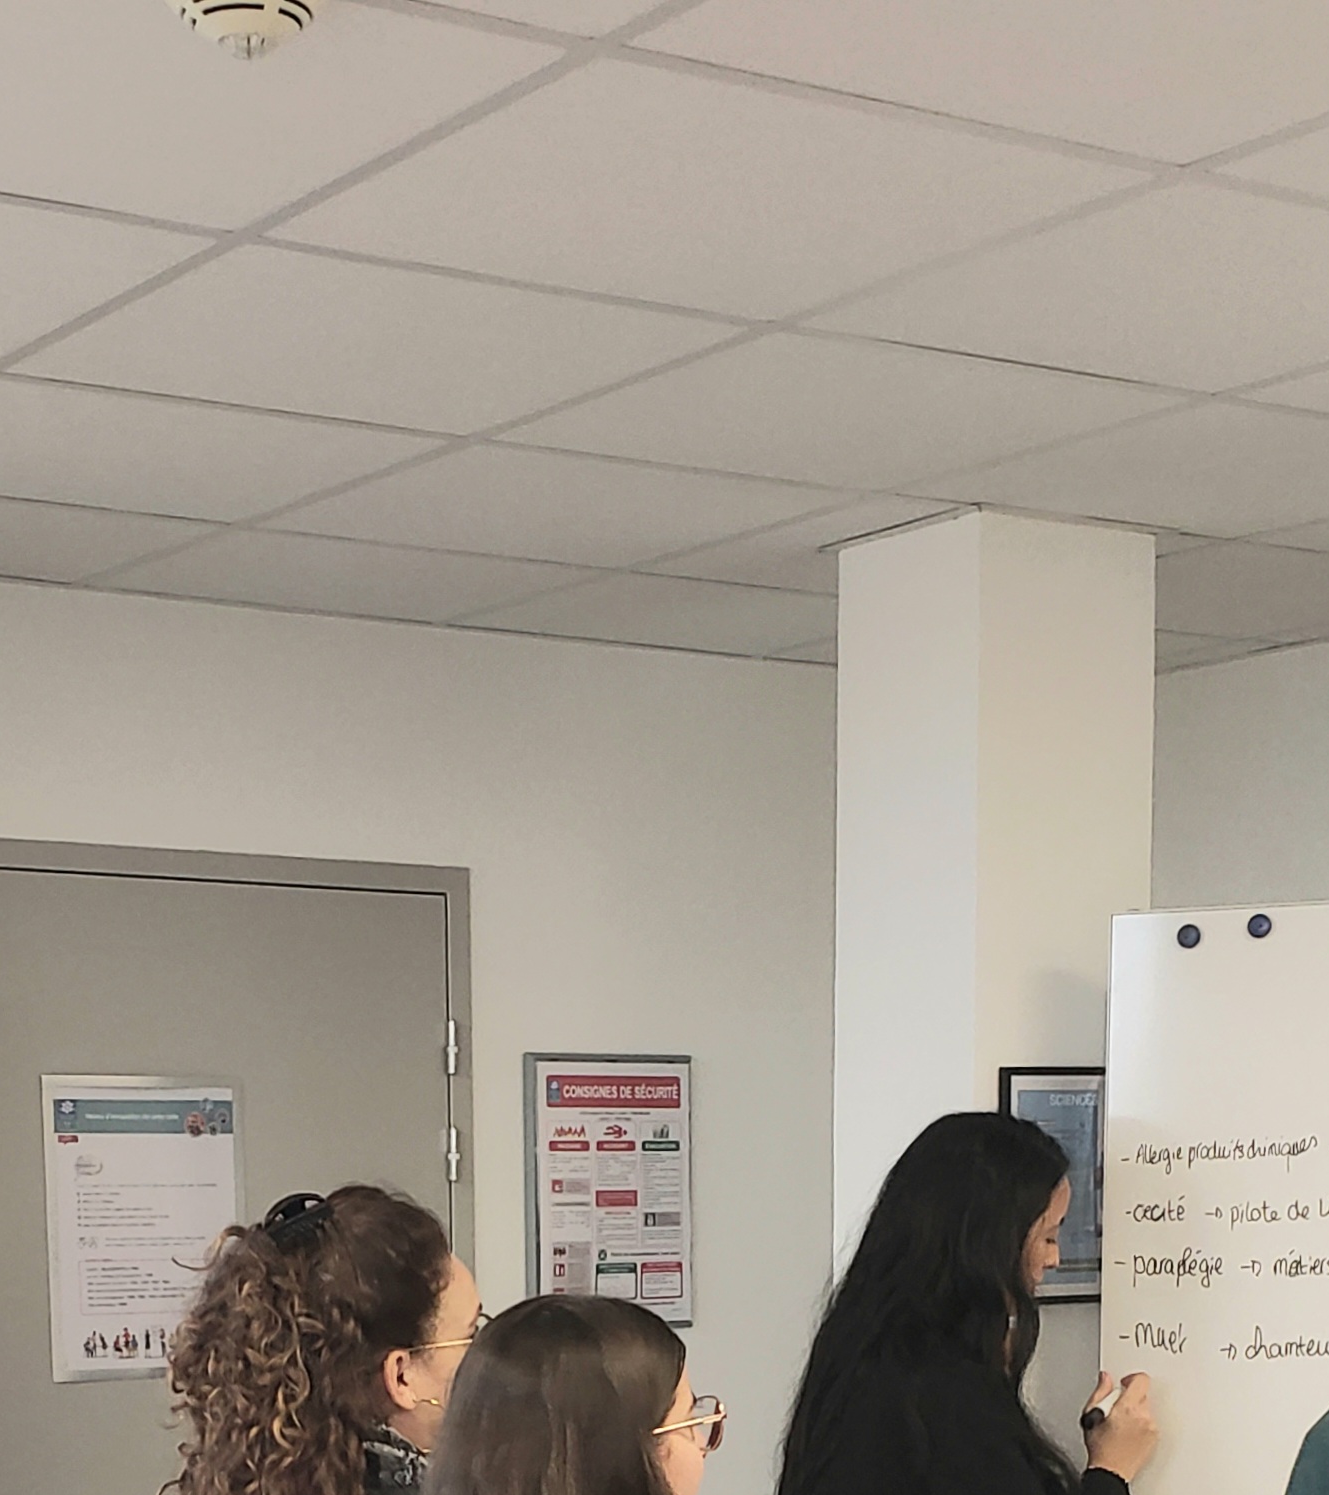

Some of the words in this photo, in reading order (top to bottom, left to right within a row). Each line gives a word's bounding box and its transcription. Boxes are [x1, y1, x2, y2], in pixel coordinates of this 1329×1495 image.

[562, 1085, 618, 1099] CONSIGNES
[619, 1086, 632, 1099] DE
[634, 1083, 679, 1100] SÉCURITÉ
[1230, 1200, 1281, 1231] pilote
[1287, 1199, 1310, 1220] de
[1132, 1246, 1223, 1288] paraplégie
